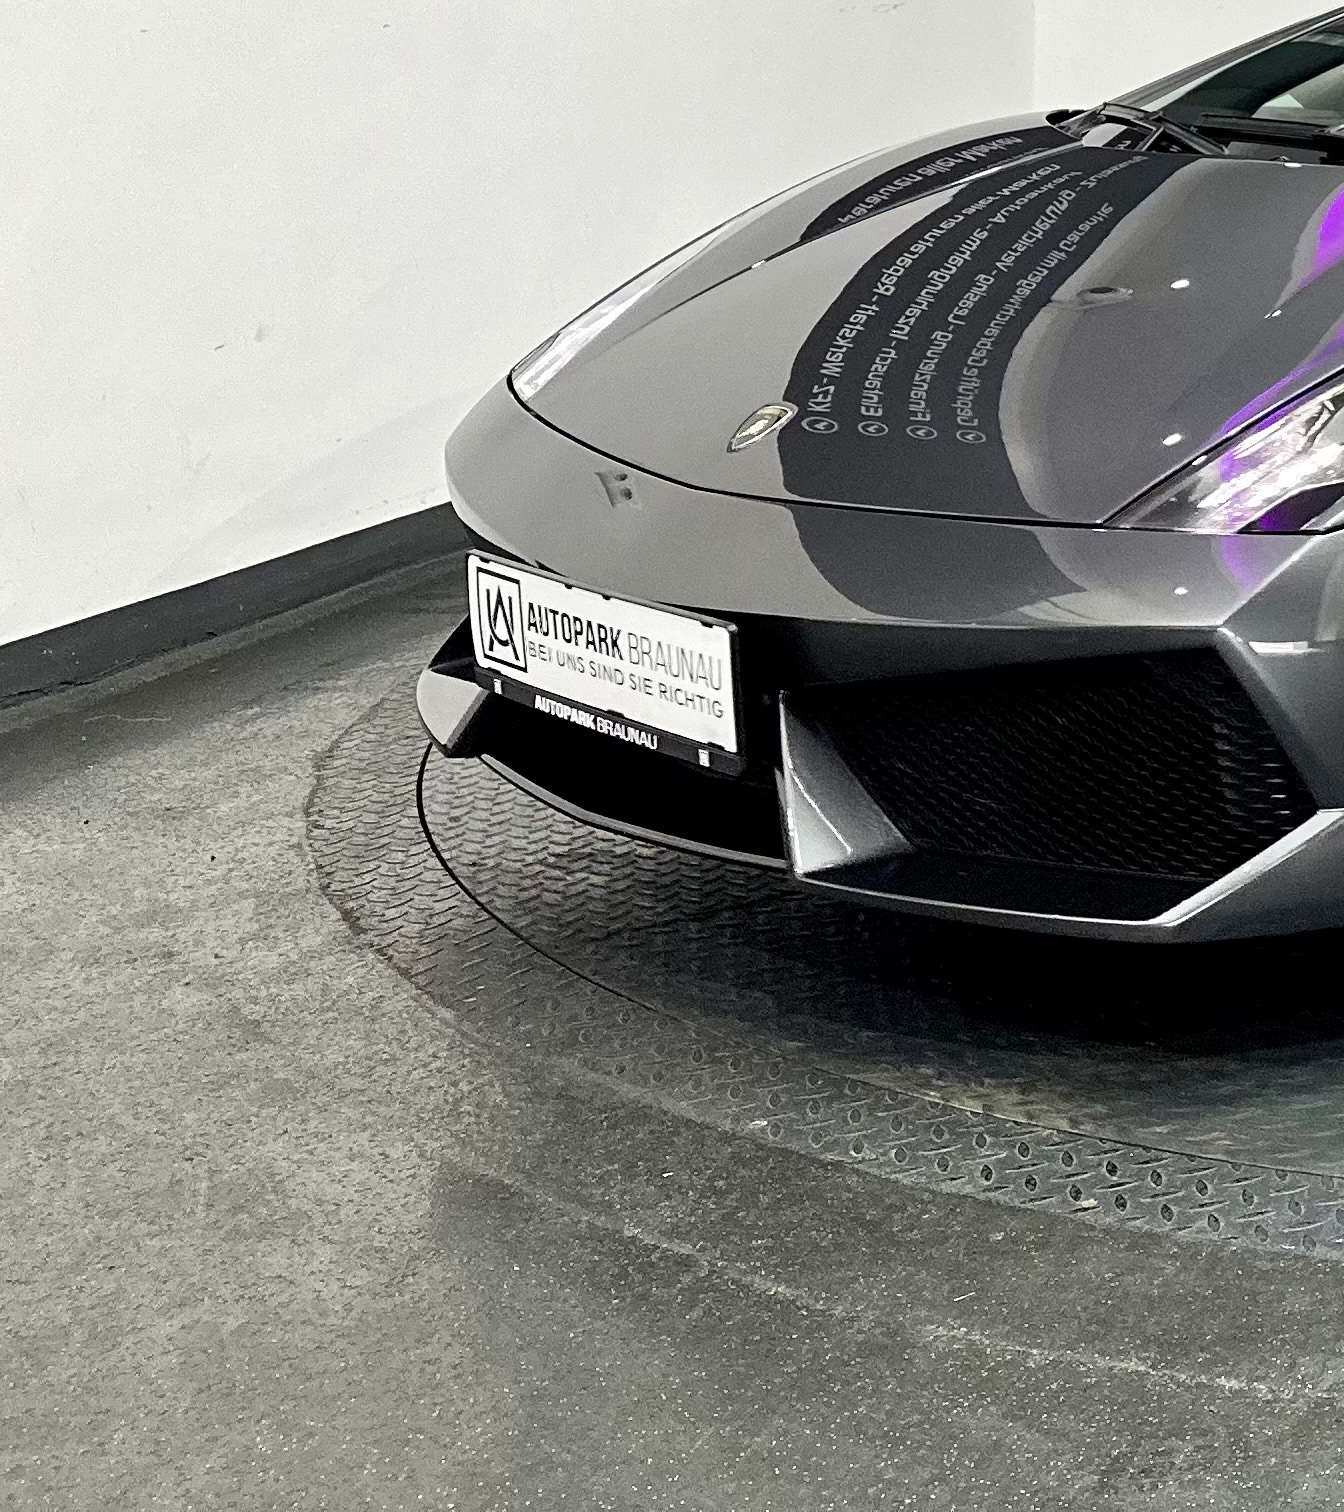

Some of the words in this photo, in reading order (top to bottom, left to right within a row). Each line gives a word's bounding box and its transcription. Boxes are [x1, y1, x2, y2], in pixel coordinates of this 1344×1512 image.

[527, 602, 624, 660] AUTOPARK
[627, 632, 723, 690] BRAUNAU
[528, 641, 553, 662] BEI
[556, 652, 585, 674] UNS
[589, 661, 625, 686] SIND
[629, 673, 654, 696] SIE
[658, 682, 724, 719] RICHTIG
[534, 695, 596, 729] AUTOPARK
[596, 716, 659, 750] BRAUNAU
